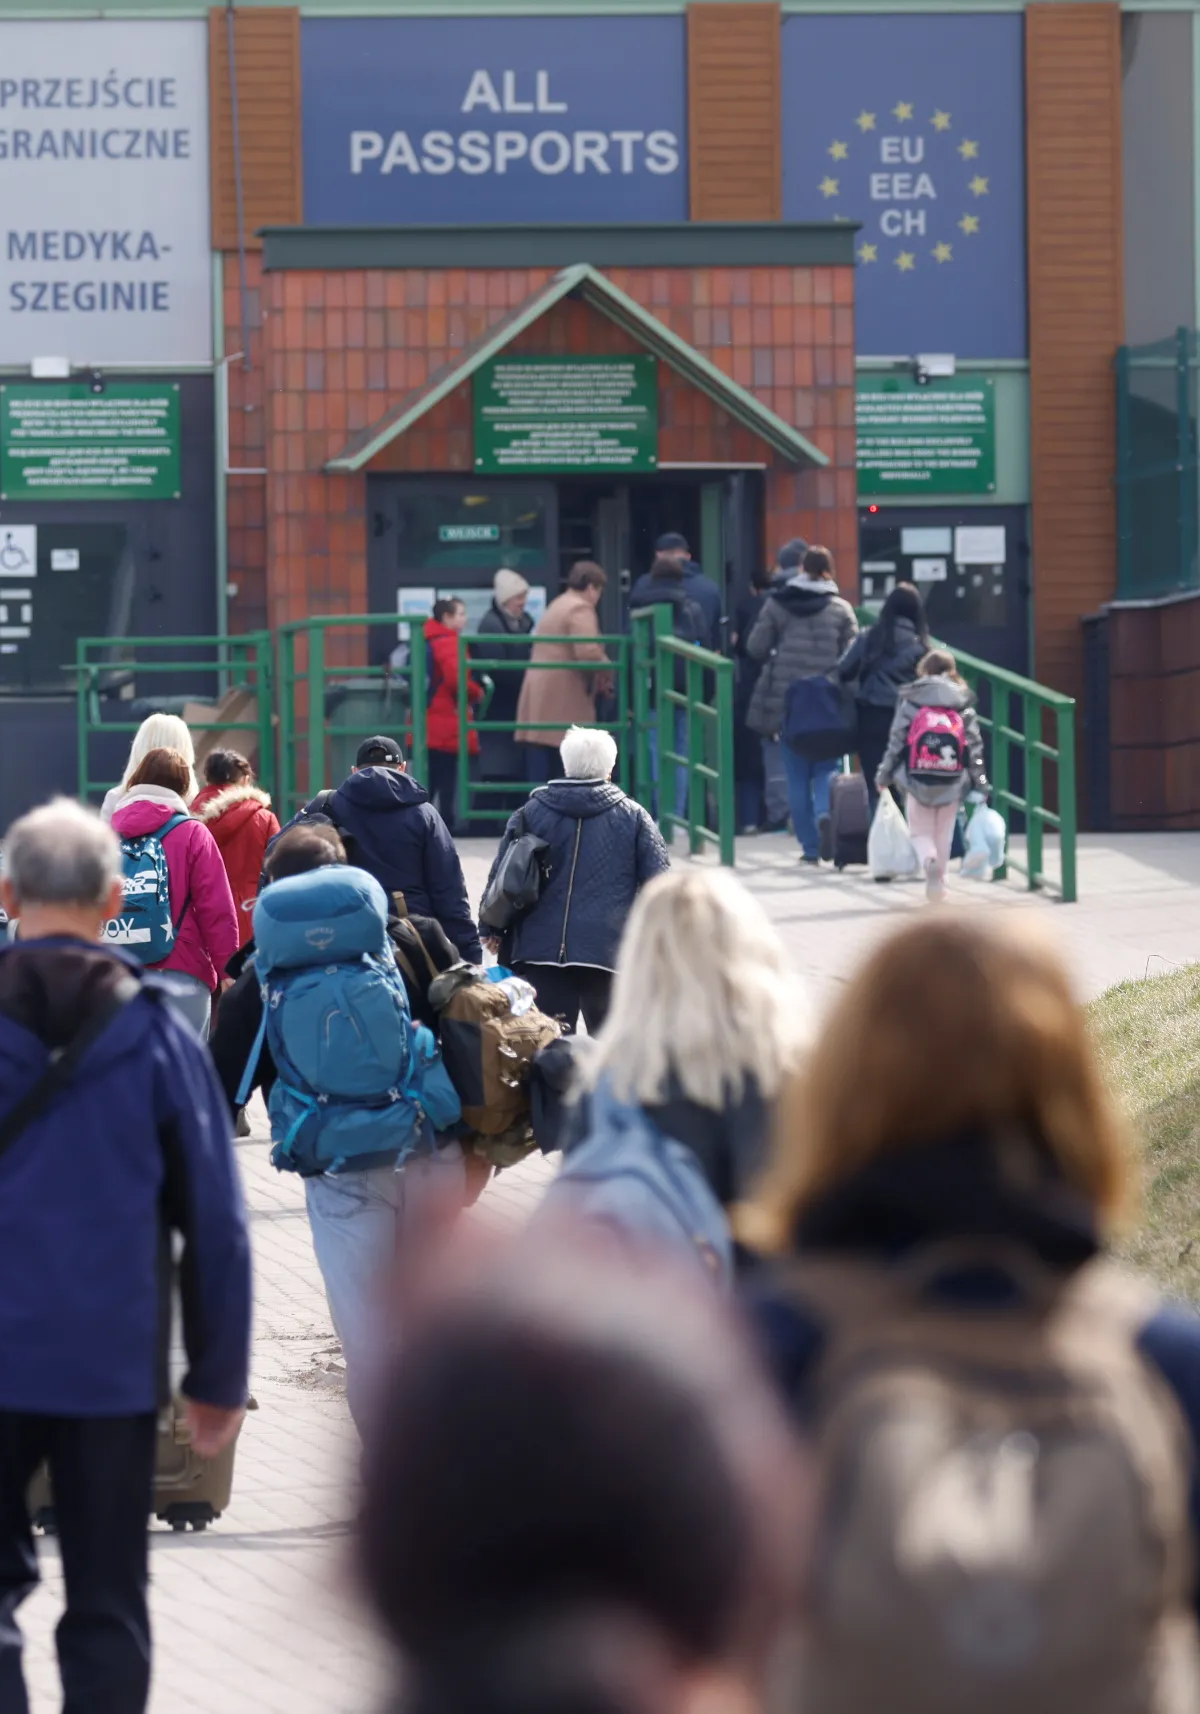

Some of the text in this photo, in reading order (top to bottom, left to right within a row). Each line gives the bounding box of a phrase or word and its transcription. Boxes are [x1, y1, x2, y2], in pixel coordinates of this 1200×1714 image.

[462, 70, 568, 114] ALL
[350, 130, 679, 175] PASSPORTS
[880, 136, 924, 165] EU
[870, 173, 937, 200] EEA
[879, 209, 926, 237] CH
[7, 231, 171, 261] MEDYKA-
[9, 280, 170, 312] SZEGINIE
